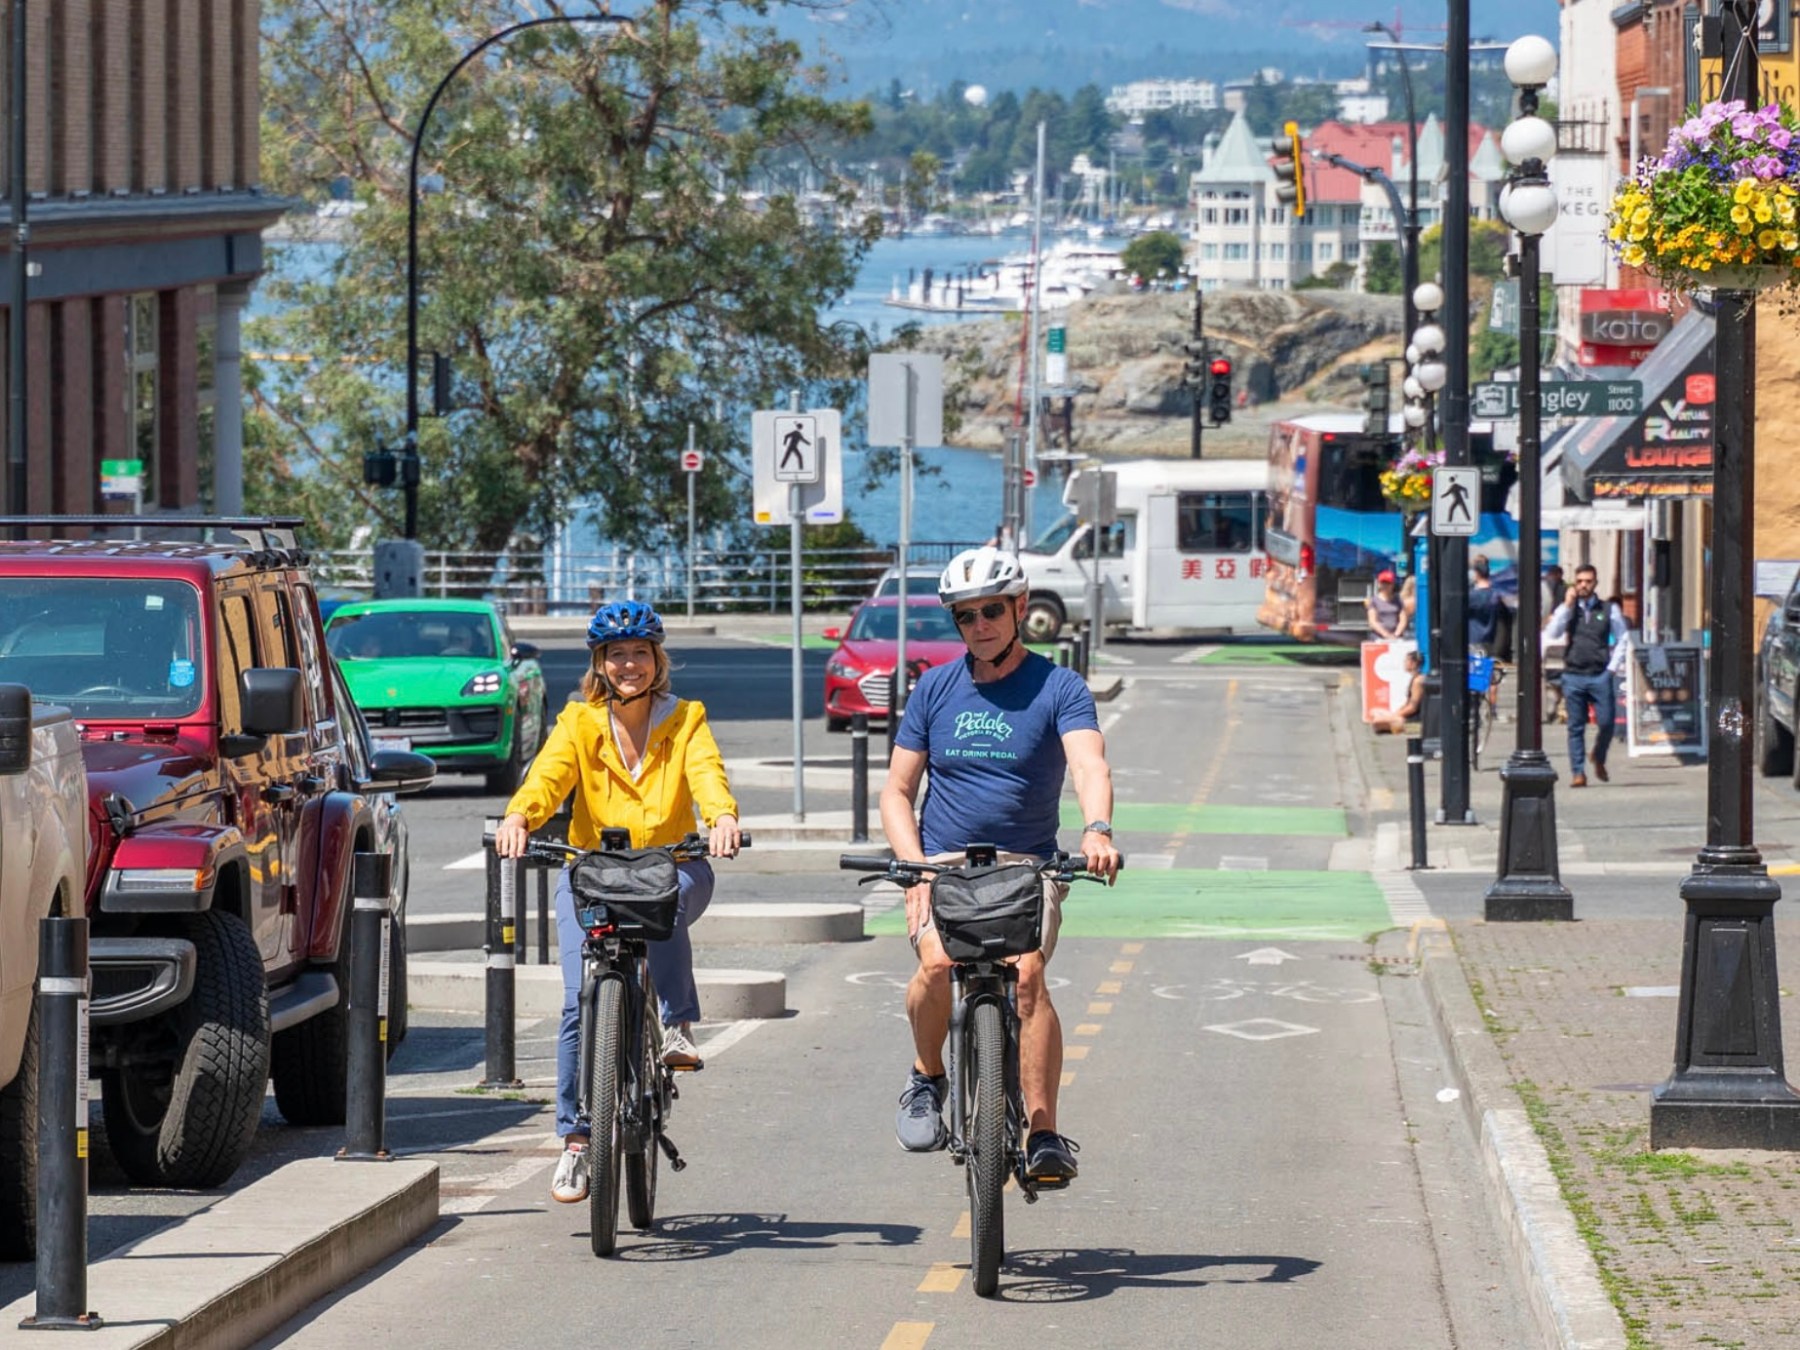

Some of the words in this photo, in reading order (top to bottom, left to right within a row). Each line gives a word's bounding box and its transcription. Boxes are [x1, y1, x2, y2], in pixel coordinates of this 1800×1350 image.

[1566, 187, 1593, 197] THE
[1560, 202, 1599, 216] KEG
[1592, 311, 1661, 340] koto
[1608, 385, 1634, 394] Street
[1512, 386, 1591, 412] Lngley
[1608, 399, 1634, 411] 1100
[954, 711, 1013, 738] Pedaler
[945, 749, 960, 757] EAT
[962, 750, 988, 758] DRINK
[990, 751, 1018, 759] PEDAL
